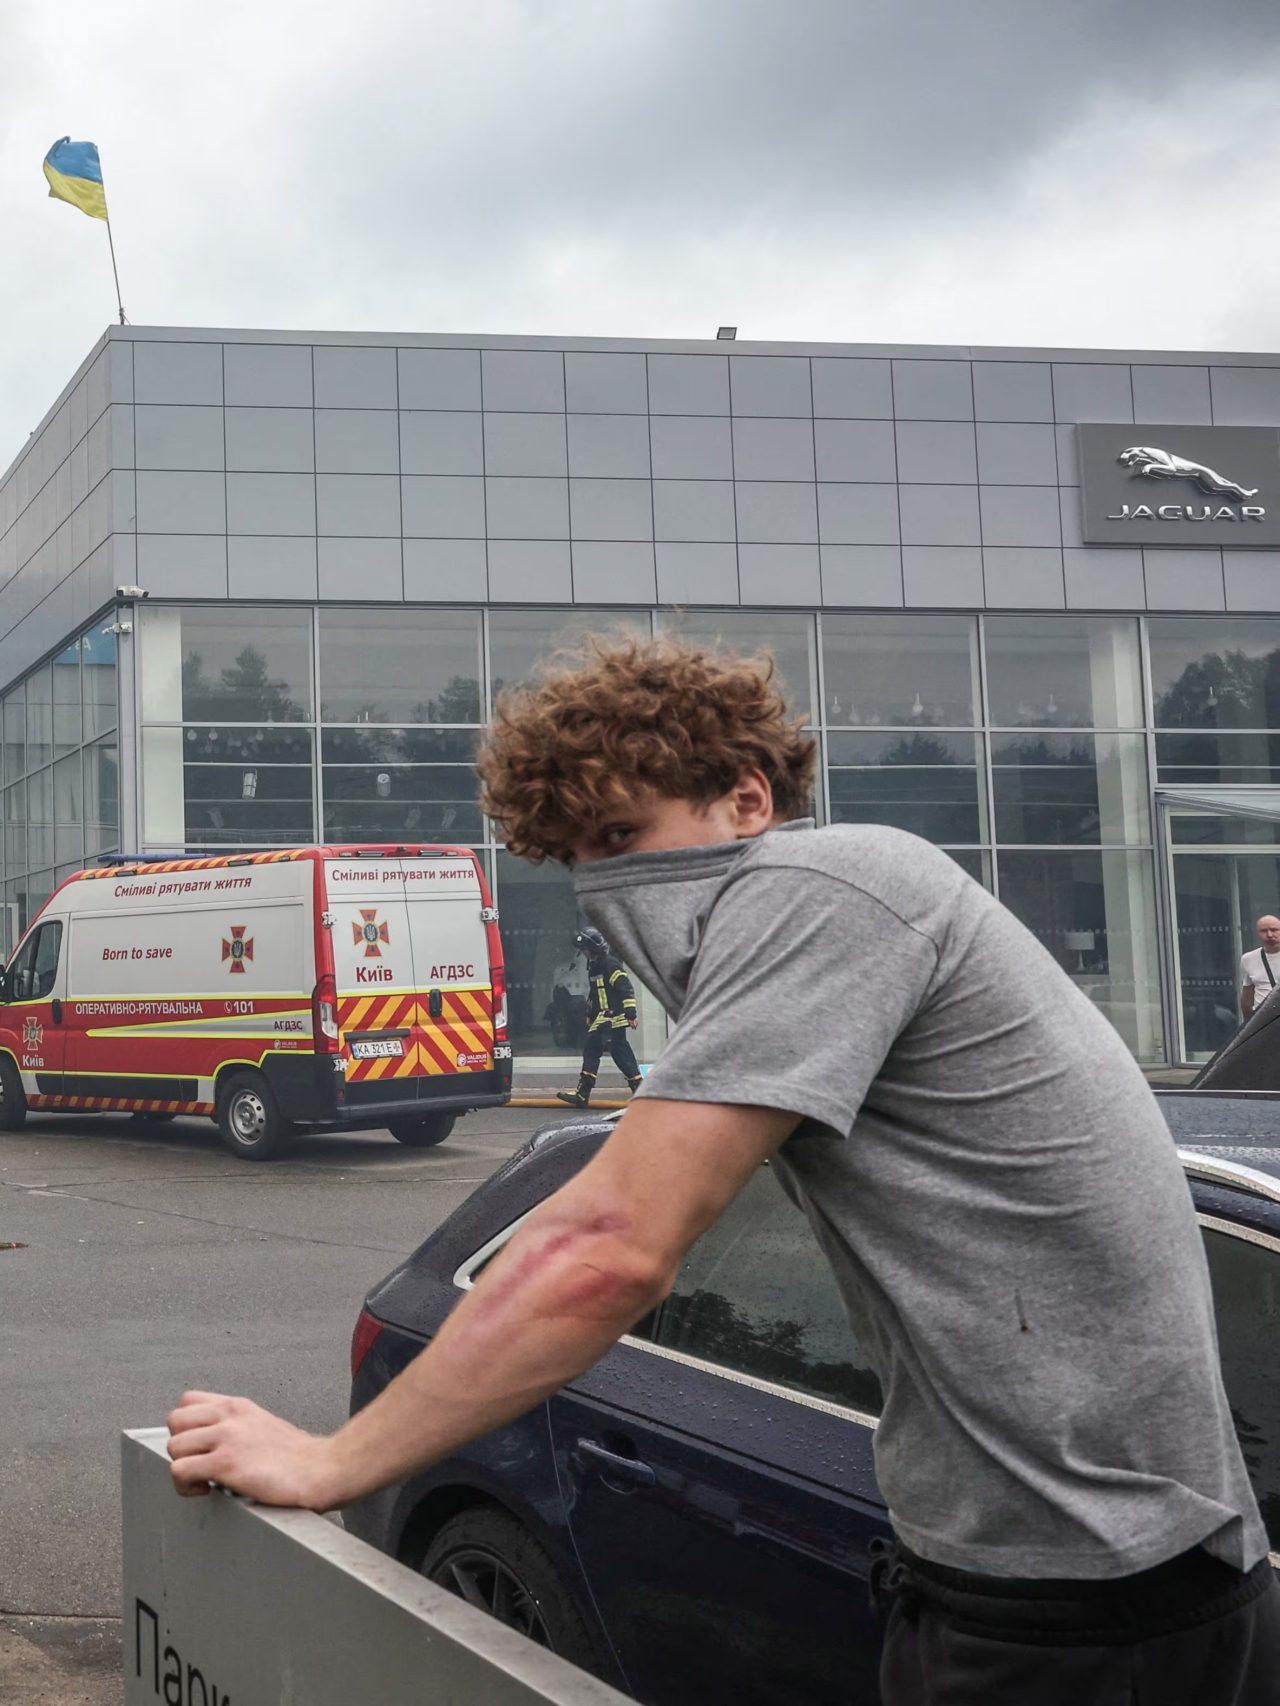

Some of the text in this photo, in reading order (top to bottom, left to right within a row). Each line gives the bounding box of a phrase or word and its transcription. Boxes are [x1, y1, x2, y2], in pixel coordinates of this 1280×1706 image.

[1106, 504, 1266, 521] JAGUAR
[332, 869, 474, 883] Сміливі рятувати життя
[114, 877, 252, 898] Сміливі рятувати життя
[102, 947, 173, 961] Born to save
[356, 965, 393, 983] Київ
[430, 964, 474, 981] АГДЗС
[75, 1001, 203, 1015] ОПЕРАТИВНО-РЯТУВАЛЬНА
[233, 1001, 254, 1014] 101
[274, 1021, 303, 1031] АГДЗС
[357, 1044, 370, 1055] KA
[371, 1043, 386, 1054] 321
[22, 1054, 45, 1067] Київ
